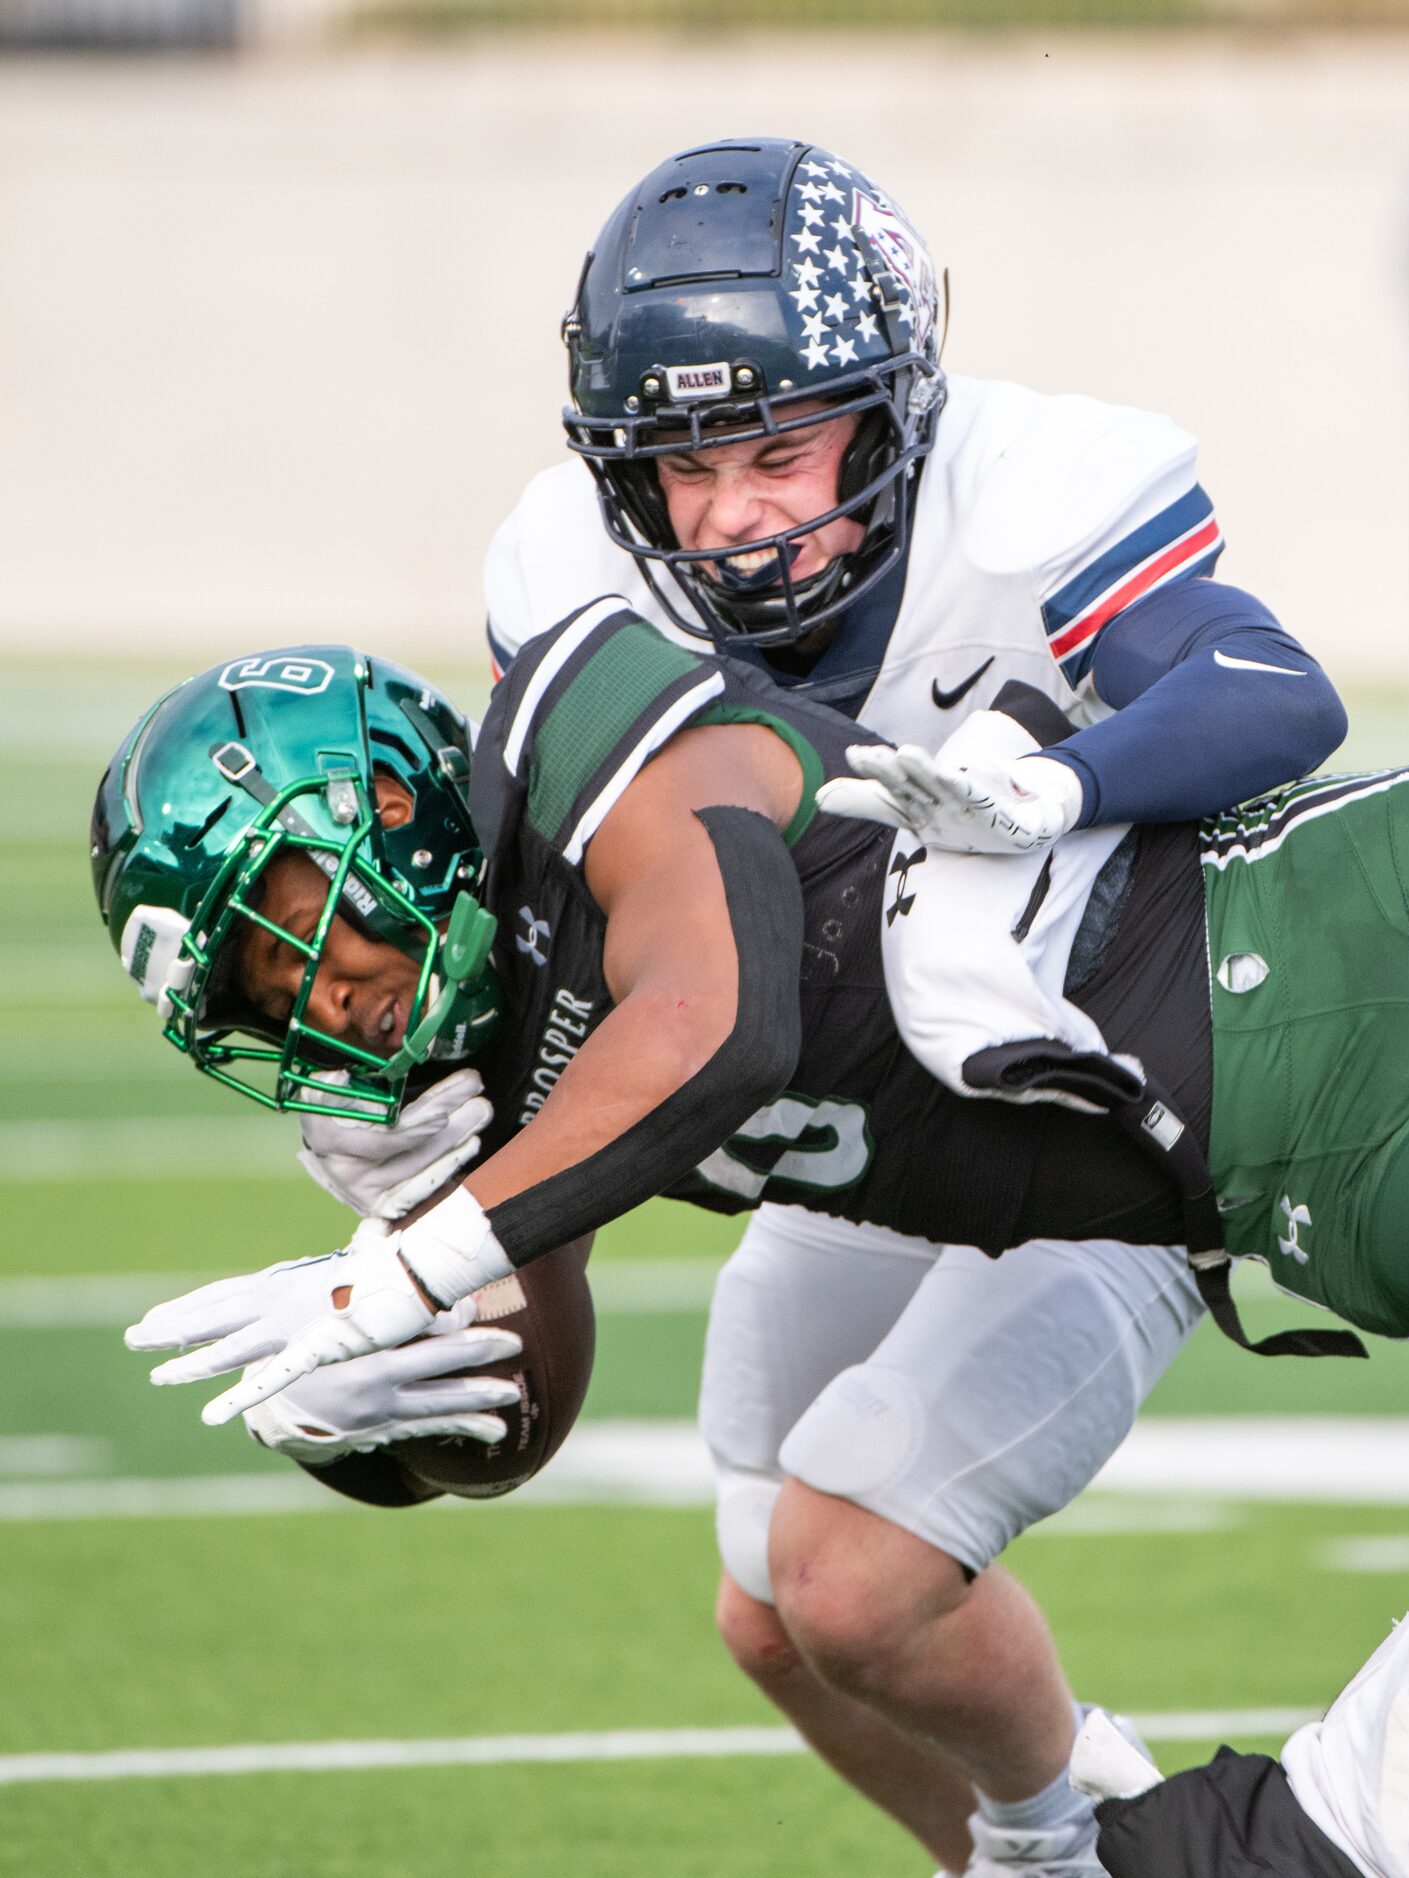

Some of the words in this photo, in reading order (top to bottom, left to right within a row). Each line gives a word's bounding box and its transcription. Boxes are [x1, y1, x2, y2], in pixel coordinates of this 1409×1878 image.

[676, 369, 724, 390] ALLEN
[217, 656, 336, 696] 6
[310, 850, 379, 917] Ridell
